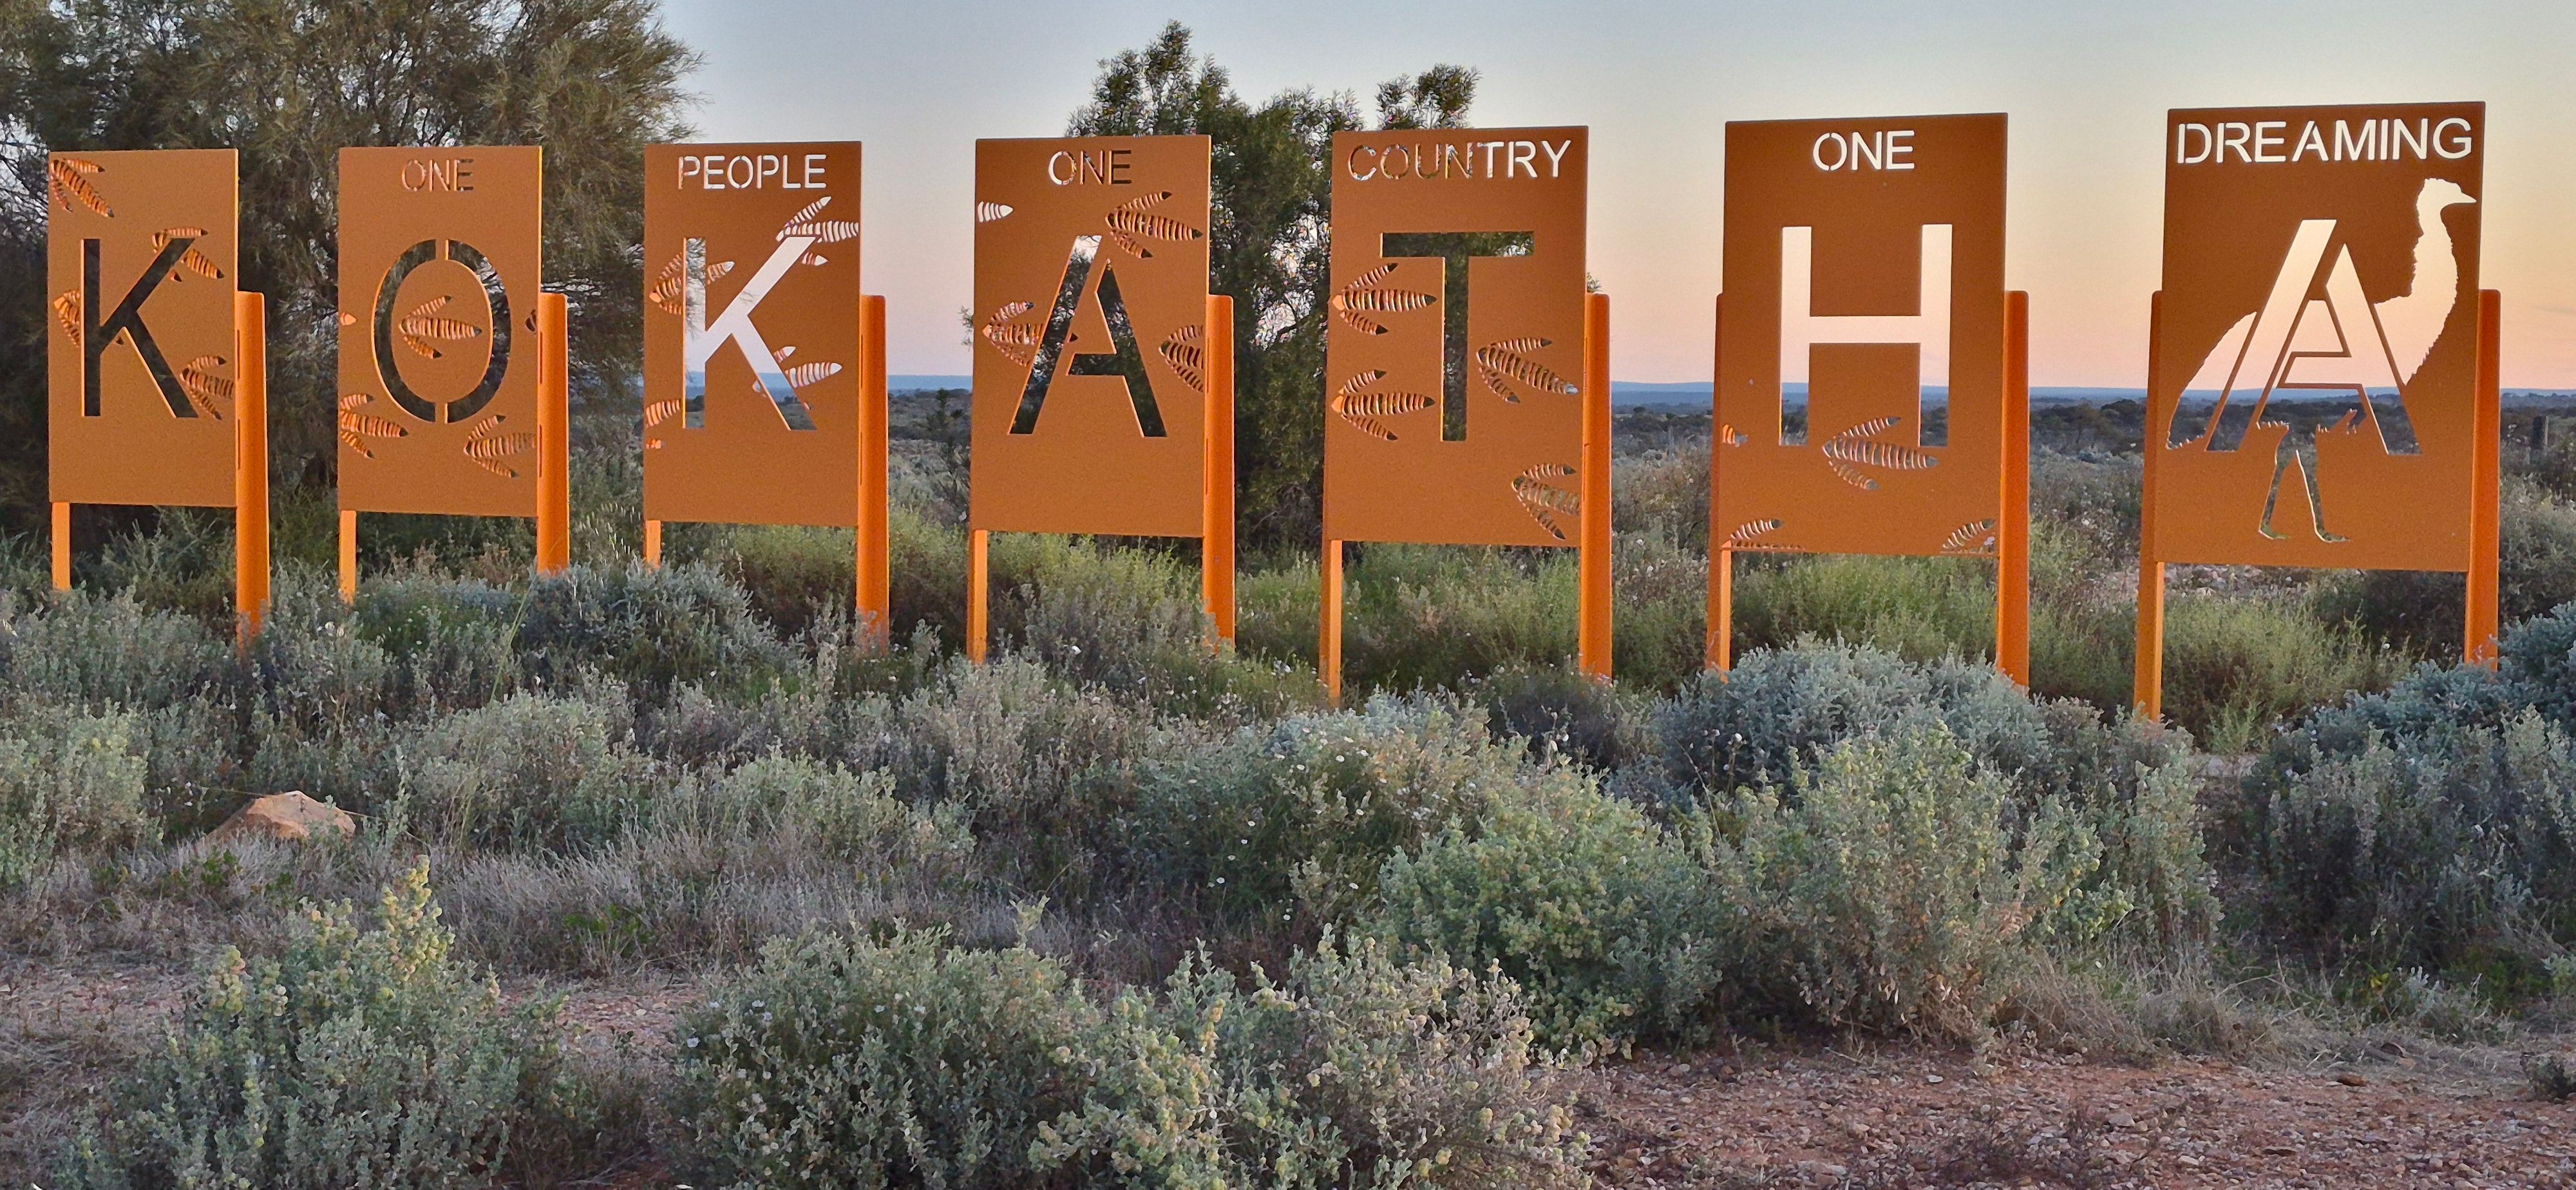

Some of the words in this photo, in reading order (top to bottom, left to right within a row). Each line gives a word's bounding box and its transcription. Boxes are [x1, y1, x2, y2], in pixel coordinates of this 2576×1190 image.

[1347, 139, 1571, 180] COUNTRY
[1812, 129, 1915, 172] ONE
[2176, 117, 2473, 164] DREAMING
[401, 158, 475, 191] ONE
[677, 153, 828, 189] PEOPLE
[1048, 149, 1132, 185] ONE
